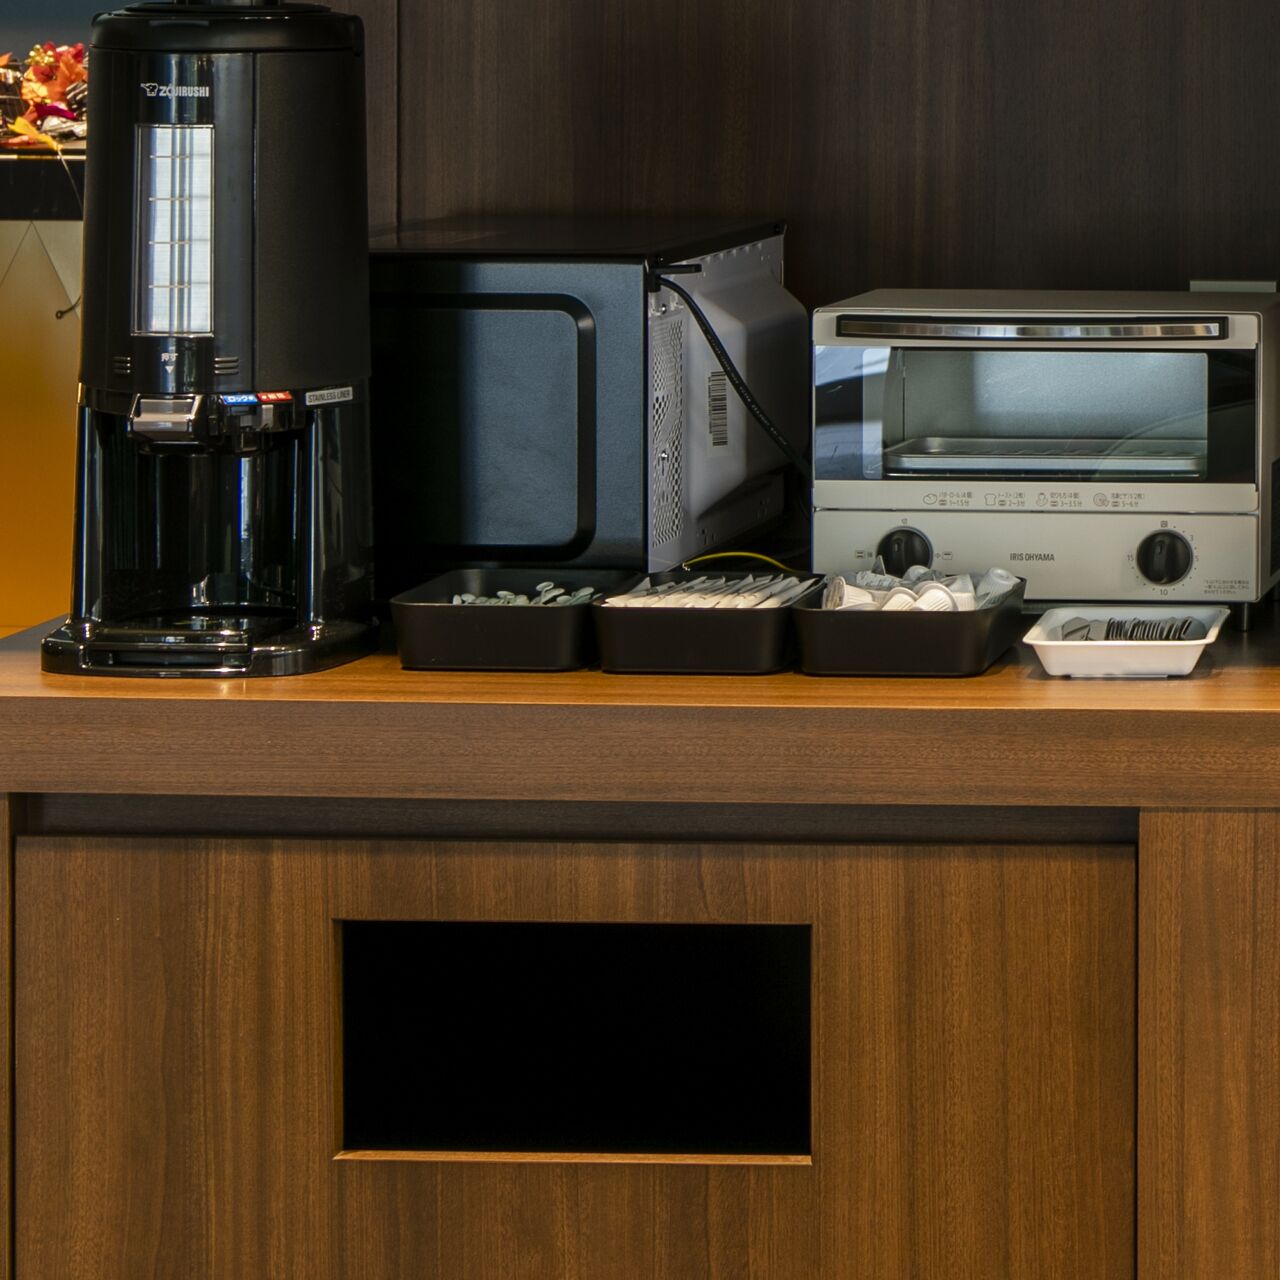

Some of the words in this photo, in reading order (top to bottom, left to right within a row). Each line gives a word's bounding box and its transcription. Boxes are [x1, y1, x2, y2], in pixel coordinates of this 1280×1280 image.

[159, 83, 209, 99] ZOJIRUSHI
[308, 391, 336, 403] STAINLESS
[337, 390, 350, 399] LINER
[1010, 553, 1024, 561] IRIS
[1025, 553, 1055, 561] OHYAMA
